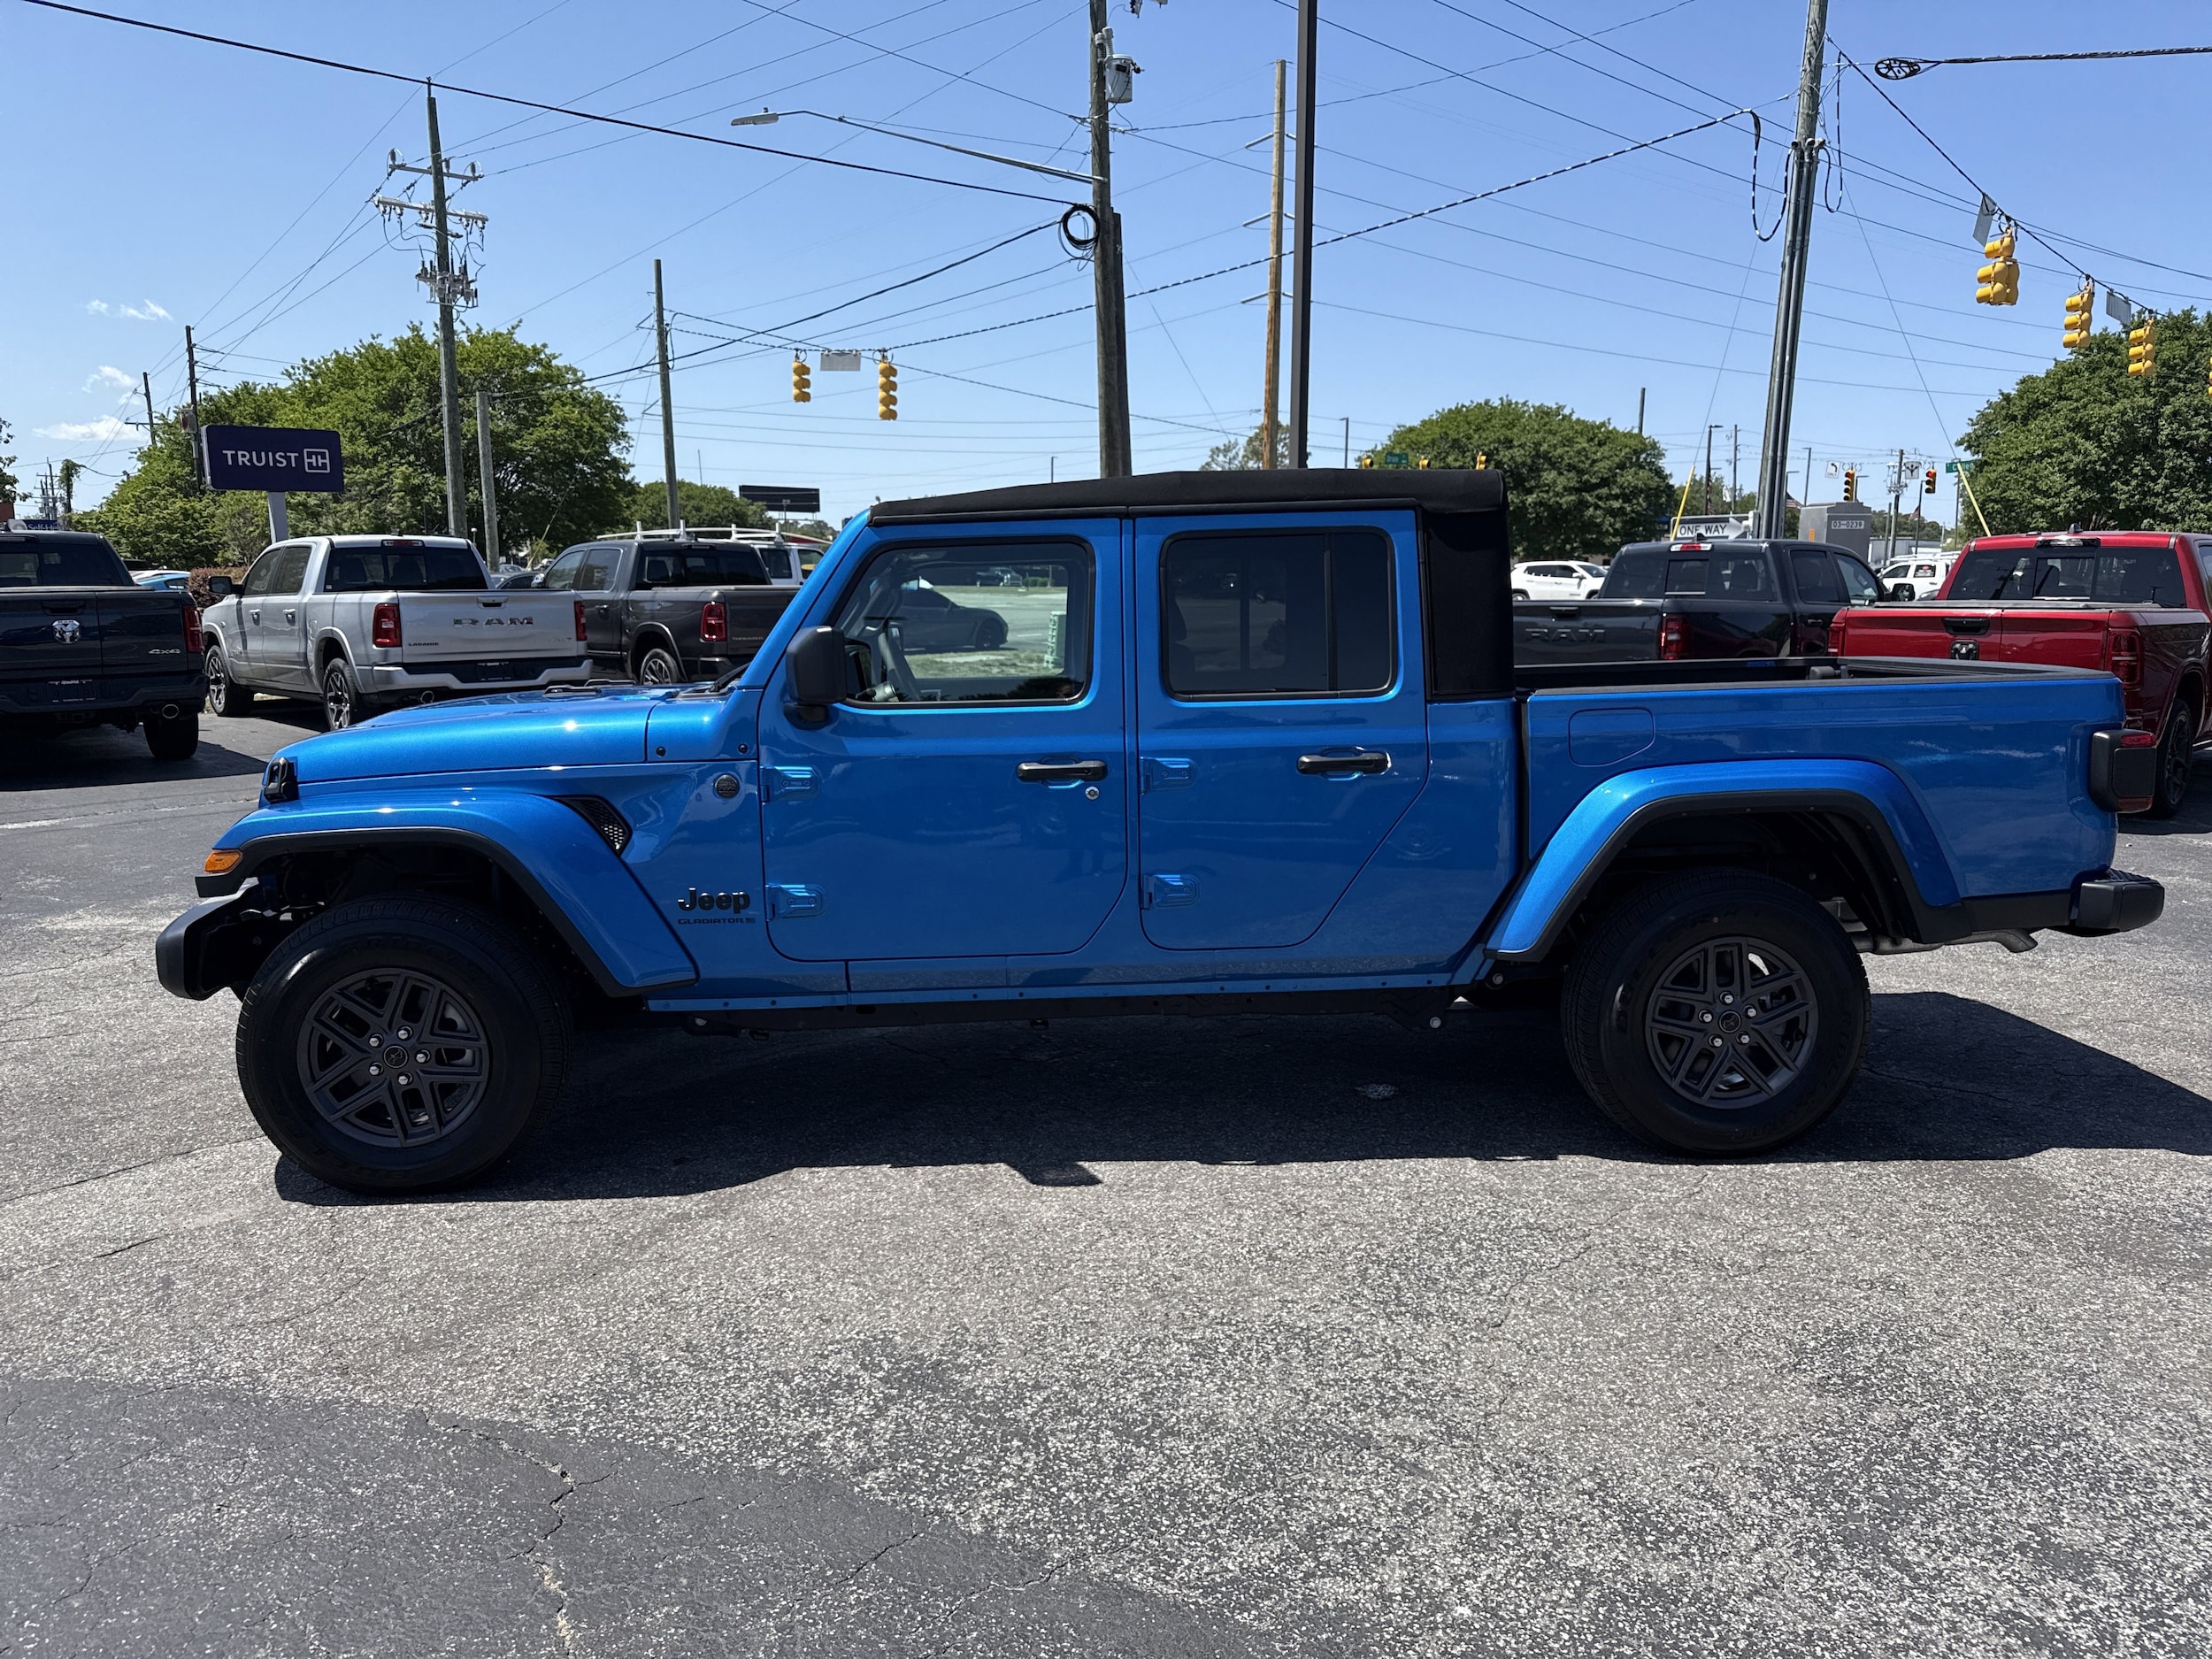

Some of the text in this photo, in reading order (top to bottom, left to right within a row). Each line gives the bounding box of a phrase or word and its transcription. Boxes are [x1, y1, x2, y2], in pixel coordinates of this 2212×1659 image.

[222, 449, 299, 468] TRUIST
[1679, 524, 1727, 535] ONE WAY
[453, 617, 534, 627] RAM
[1525, 628, 1605, 642] RAM
[677, 887, 750, 914] Jeep
